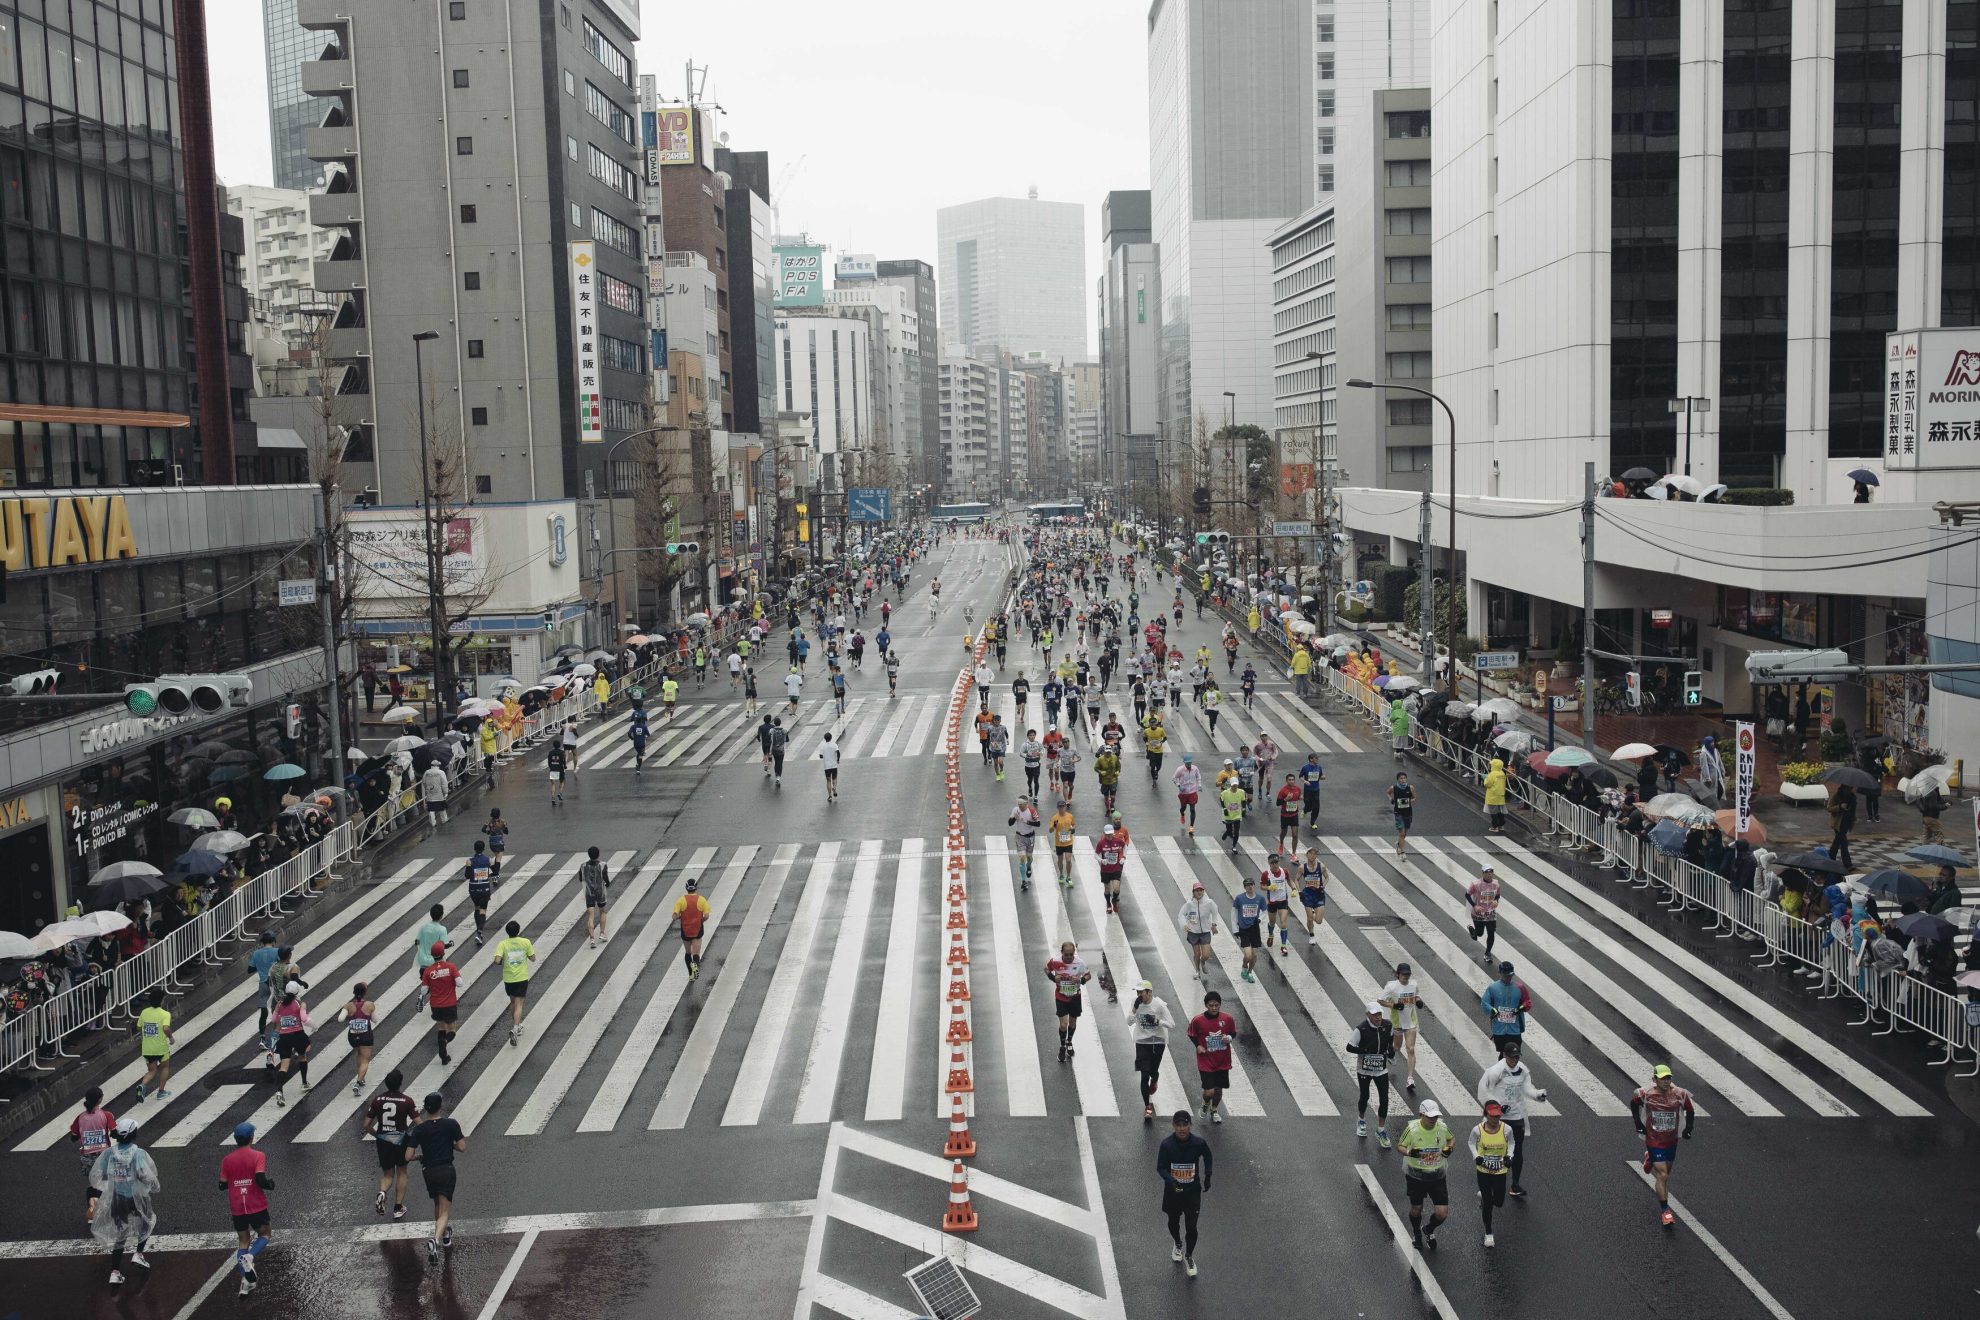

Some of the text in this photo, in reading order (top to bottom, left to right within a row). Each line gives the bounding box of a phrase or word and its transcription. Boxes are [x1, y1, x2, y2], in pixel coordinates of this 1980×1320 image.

[649, 151, 658, 181] TOMAS
[784, 256, 817, 267] はかり
[785, 271, 818, 281] POS
[786, 286, 807, 296] FA
[578, 273, 595, 387] 住友不動産販売
[1888, 371, 1900, 455] 森永製菓
[1903, 369, 1916, 454] 森永乳業
[1739, 752, 1748, 829] RUNNERS
[72, 801, 122, 830] 2F DVD レンタル
[92, 825, 101, 837] CD
[101, 819, 119, 832] レンタル
[123, 807, 142, 824] COMIC
[142, 801, 159, 816] レンタル
[75, 833, 90, 857] 1F
[92, 832, 116, 850] DVD/CD
[382, 1102, 397, 1126] 2
